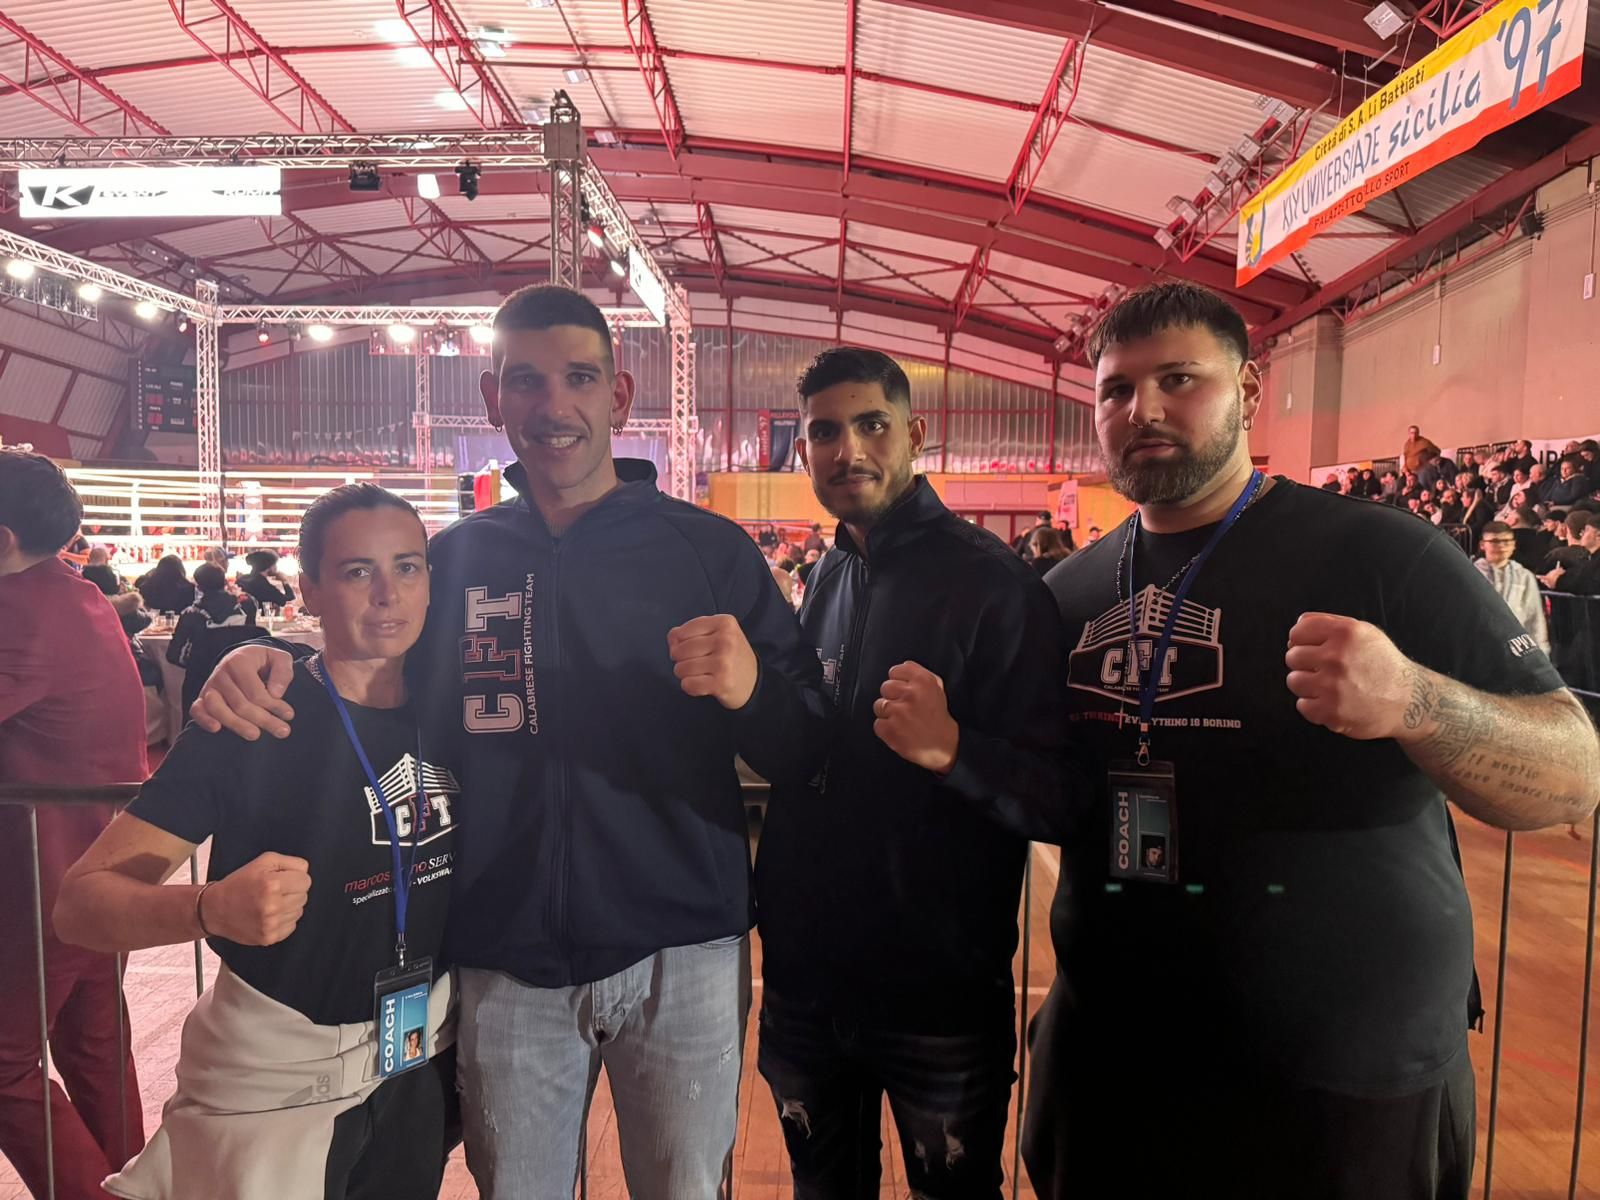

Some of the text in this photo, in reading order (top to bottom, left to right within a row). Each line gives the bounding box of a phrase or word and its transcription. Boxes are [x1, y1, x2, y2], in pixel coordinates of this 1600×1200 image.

[1338, 123, 1347, 142] di
[1368, 99, 1377, 119] Li
[1379, 64, 1426, 110] Battiati
[1388, 67, 1481, 160] sicilia
[1384, 161, 1410, 187] SPORT
[462, 586, 524, 734] CFT
[523, 573, 539, 735] CALABRESE FIGHTING TEAM
[1101, 640, 1178, 685] CFT
[1203, 717, 1242, 728] BORING
[1117, 791, 1130, 870] COACH
[384, 998, 396, 1073] COACH
